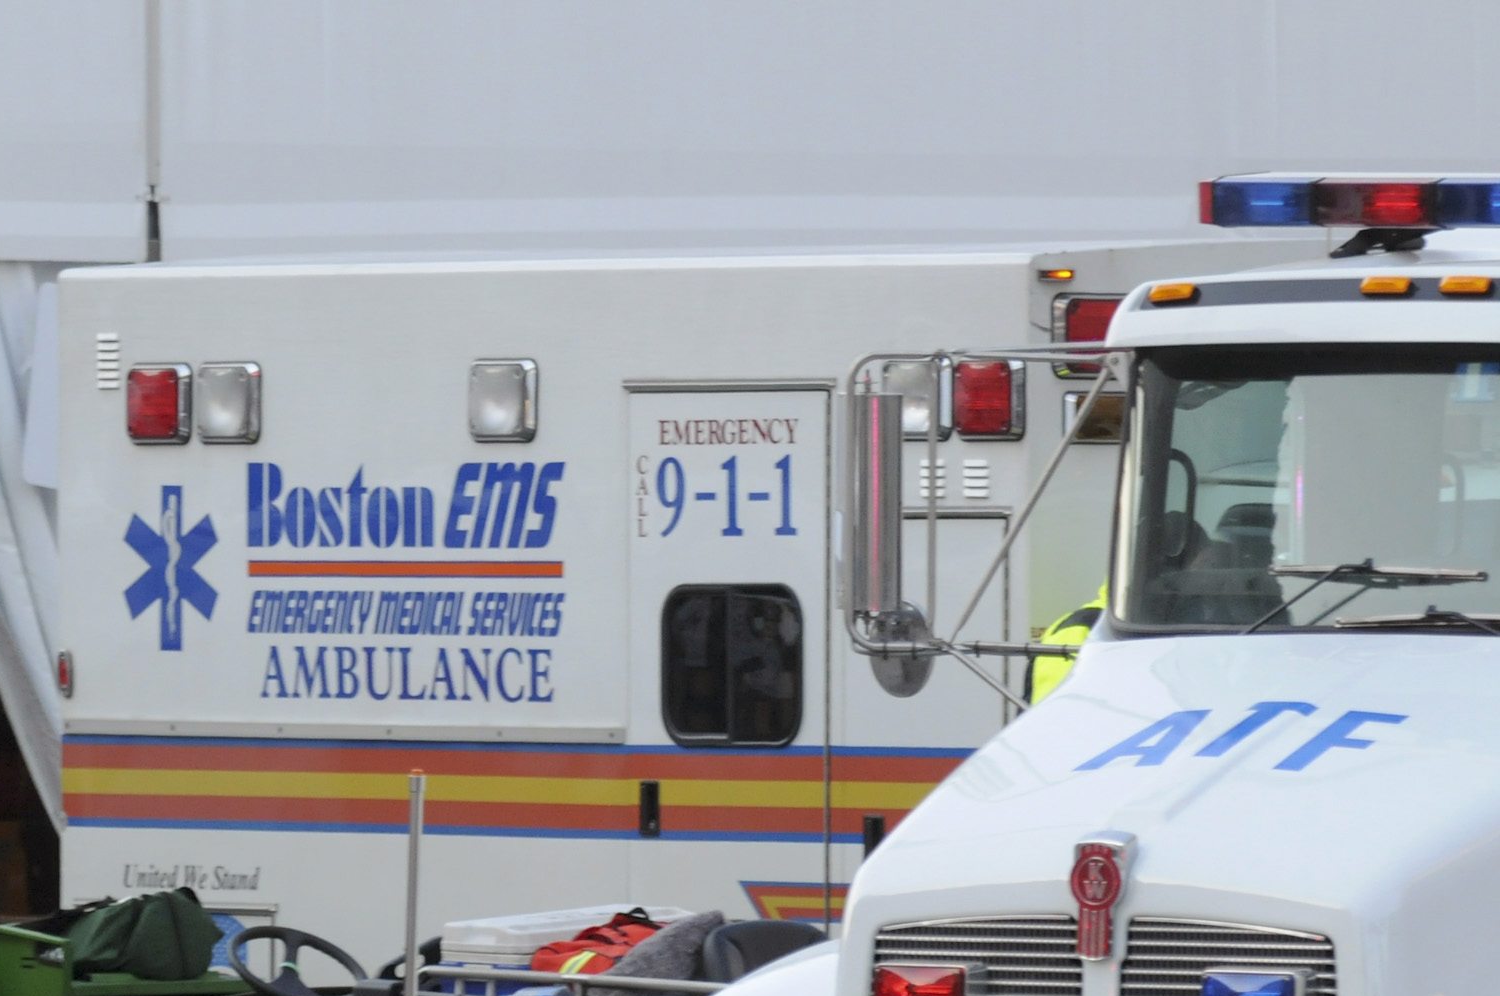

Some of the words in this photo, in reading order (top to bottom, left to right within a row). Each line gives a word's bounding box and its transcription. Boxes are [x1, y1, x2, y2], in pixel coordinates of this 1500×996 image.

[658, 418, 799, 446] EMERGENCY
[246, 462, 435, 549] Boston
[443, 461, 566, 549] EMS
[635, 455, 649, 538] CALL
[656, 454, 798, 538] 9-1-1
[247, 590, 374, 634] EMERGENCY
[374, 591, 465, 636] MEDICAL
[467, 592, 566, 637] SERVICES
[261, 646, 555, 703] AMBULANCE
[1073, 701, 1409, 772] ATF
[122, 864, 179, 889] United
[183, 865, 206, 889] We
[211, 866, 261, 891] Stand
